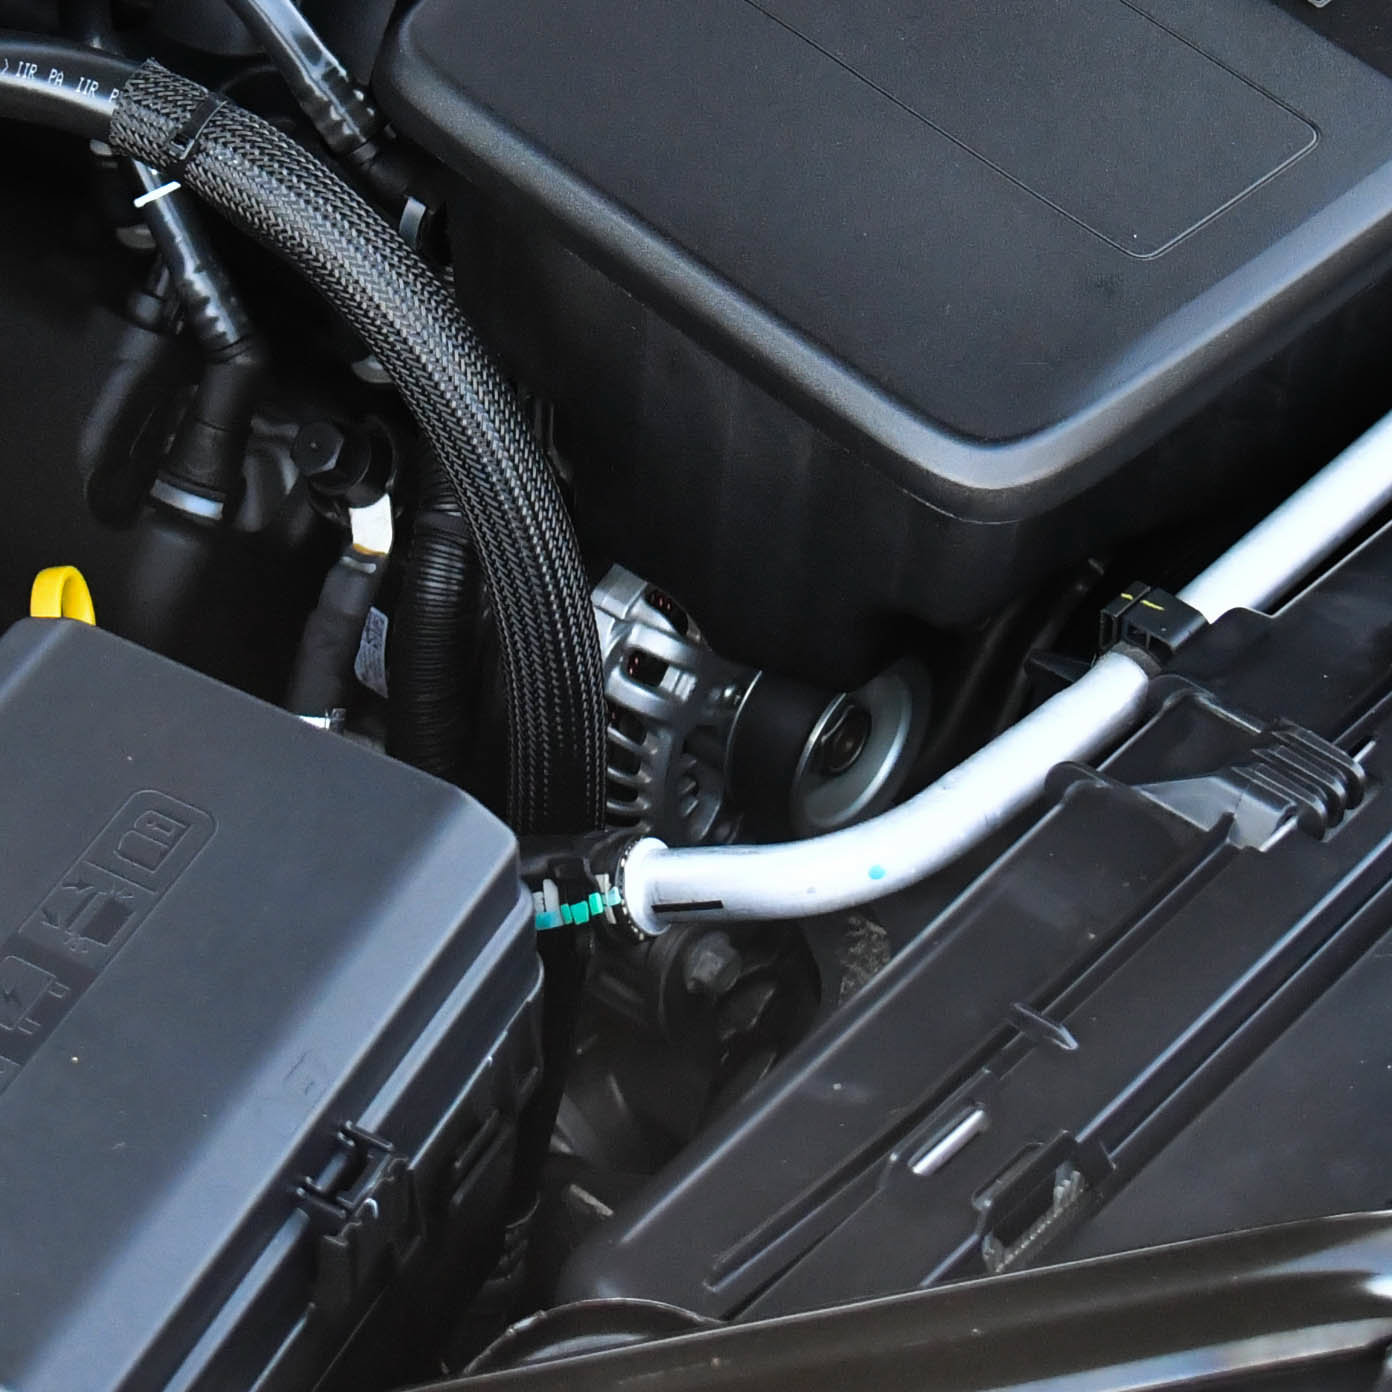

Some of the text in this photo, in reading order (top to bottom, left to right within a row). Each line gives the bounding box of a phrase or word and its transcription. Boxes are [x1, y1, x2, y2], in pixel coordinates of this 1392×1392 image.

[15, 61, 38, 81] IIR
[48, 68, 64, 88] PA
[76, 76, 99, 97] IIR
